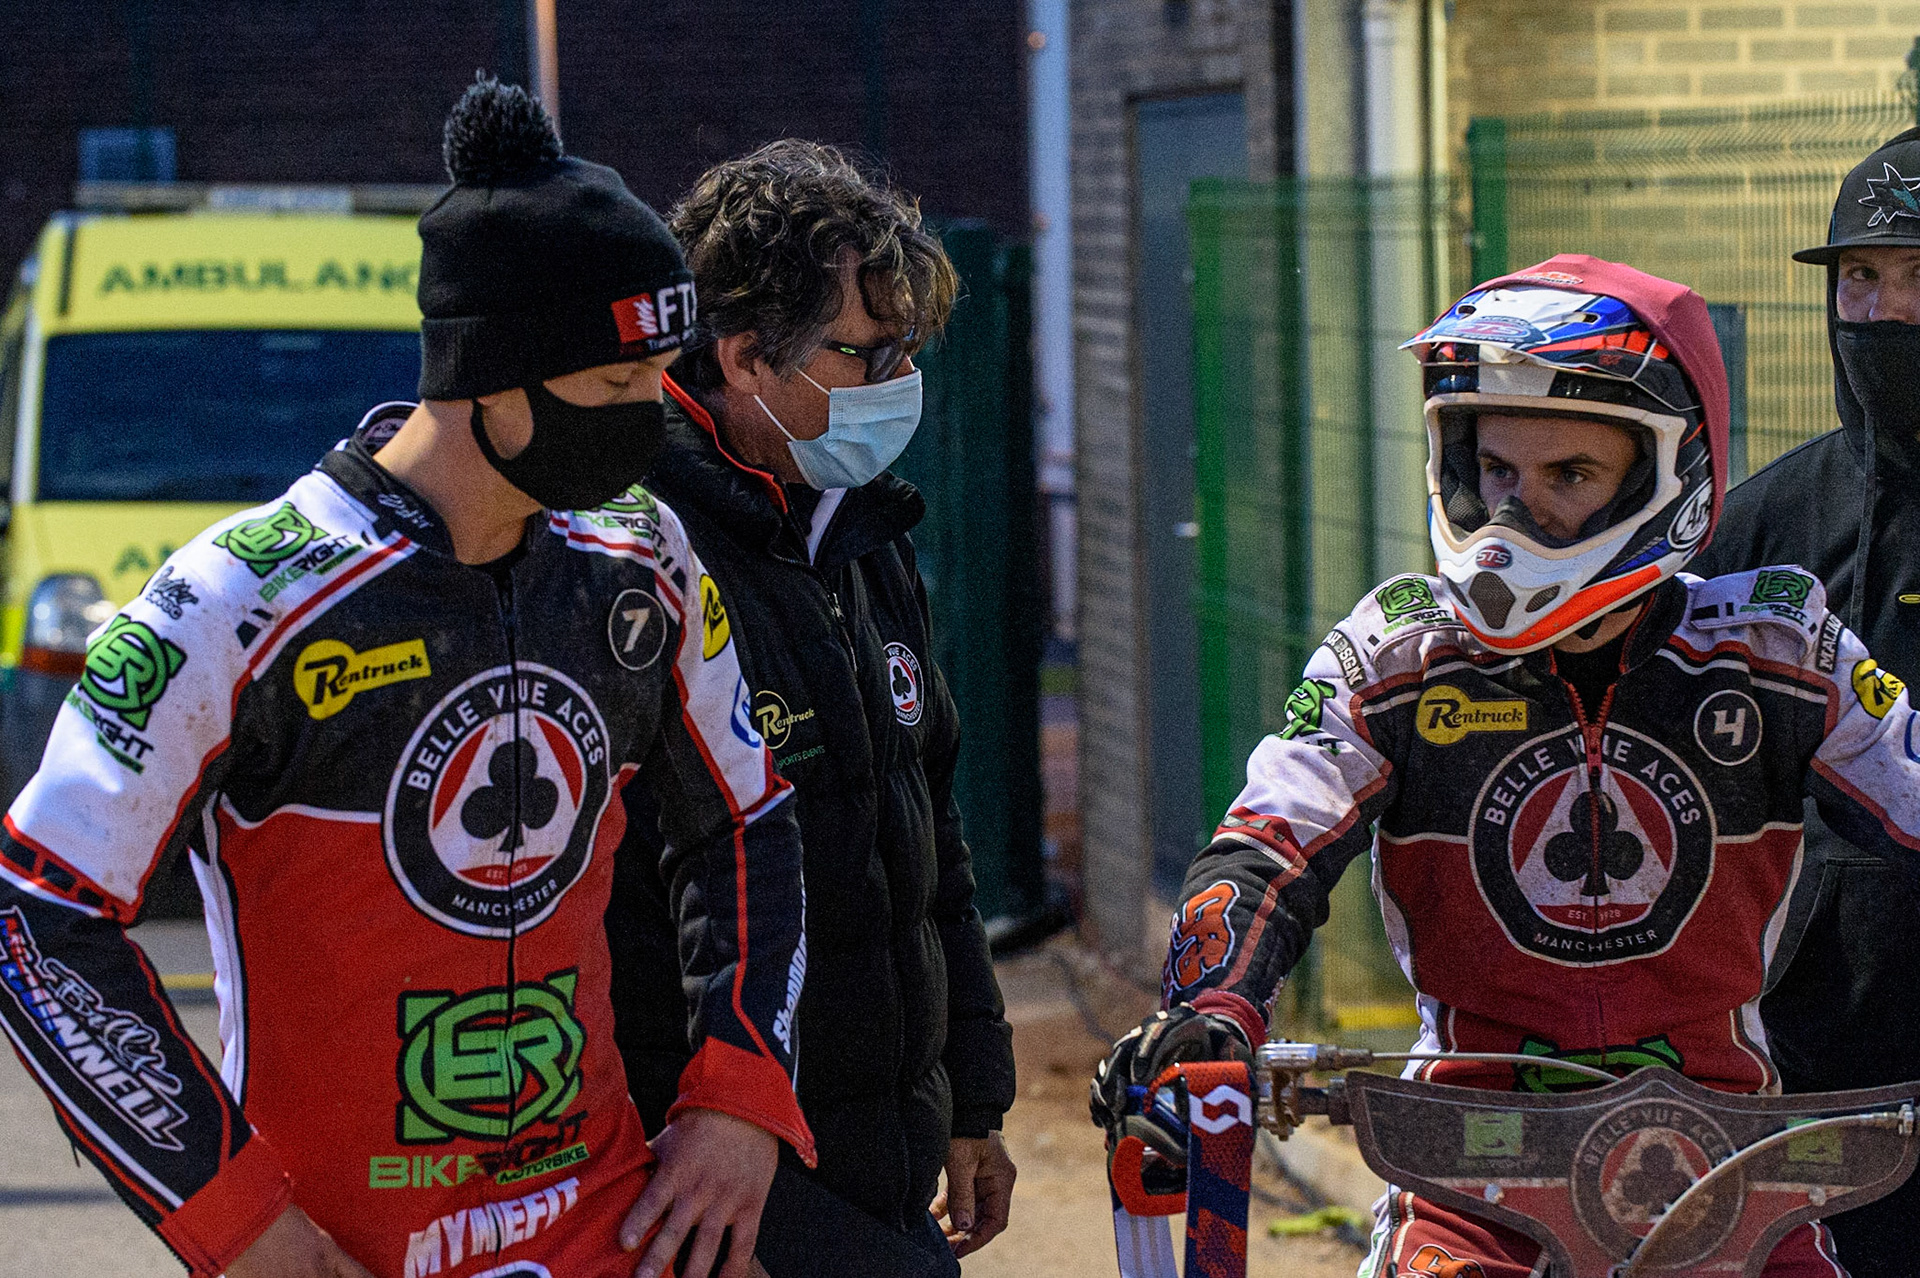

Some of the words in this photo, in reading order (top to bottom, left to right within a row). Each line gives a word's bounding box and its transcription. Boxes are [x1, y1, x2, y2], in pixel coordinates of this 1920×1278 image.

[622, 607, 650, 653] 7
[303, 655, 423, 706] Rentruck
[756, 704, 816, 740] Rentruck
[1425, 698, 1523, 730] Rentruck
[1713, 708, 1746, 746] 4
[407, 701, 479, 791] BELLE
[556, 697, 605, 766] ACES
[1484, 747, 1556, 826] BELLE
[1641, 759, 1701, 825] ACES
[1533, 929, 1658, 952] MANCHESTER
